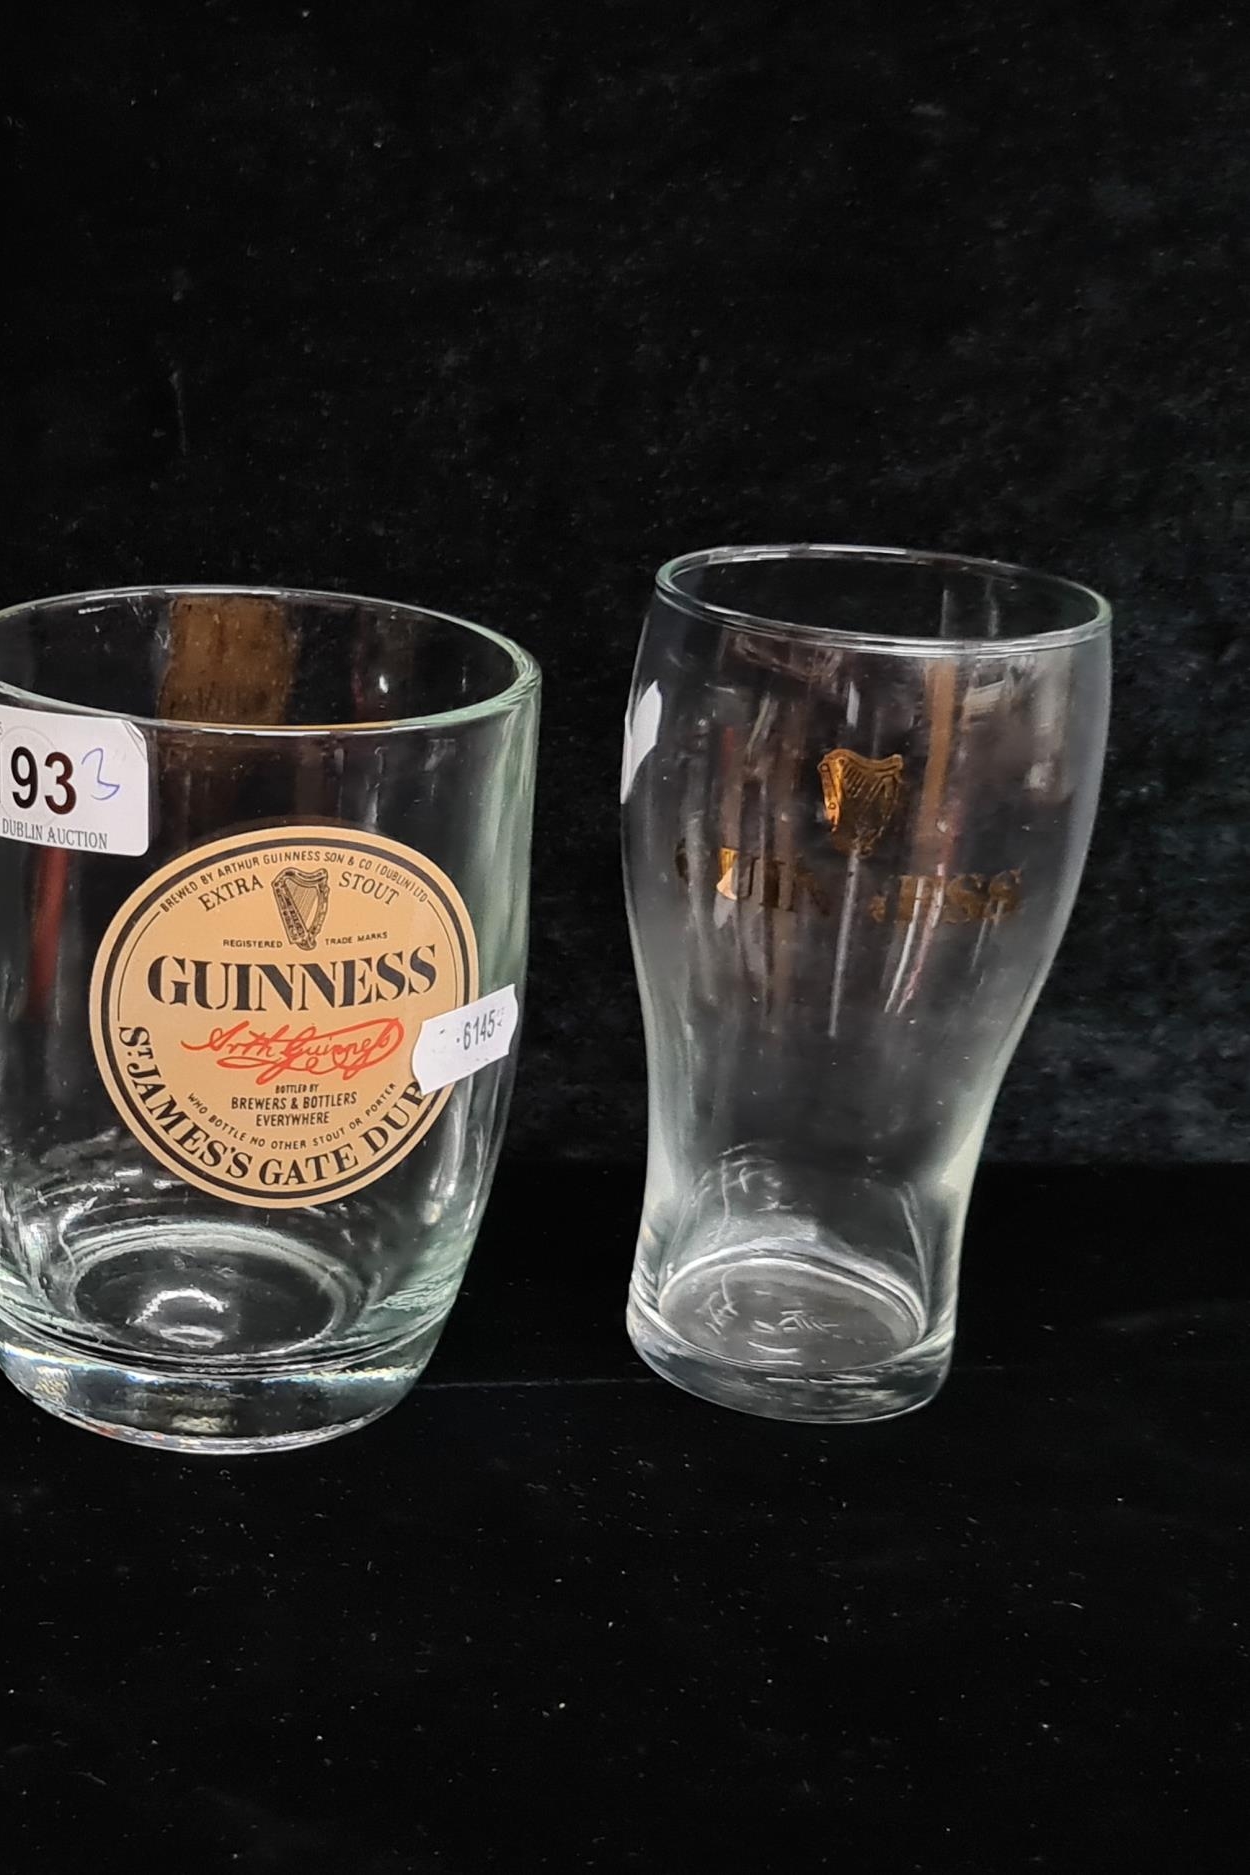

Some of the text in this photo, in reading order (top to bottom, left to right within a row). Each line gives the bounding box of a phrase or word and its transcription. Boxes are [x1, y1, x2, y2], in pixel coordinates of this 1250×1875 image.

[2, 820, 43, 841] DUBLIN
[46, 829, 108, 850] AUCTION
[160, 881, 199, 913] BREWED
[200, 872, 214, 886] BY
[217, 856, 259, 878] ARTHUR
[263, 850, 320, 865] GUINNESS
[324, 851, 344, 863] SON
[346, 855, 356, 866] &
[358, 858, 372, 871] CO
[412, 886, 429, 903] LTD
[198, 871, 400, 911] EXTRA STOUT
[223, 931, 388, 948] REGISTERED TRADE MARKS
[147, 944, 437, 1012] GUINNESS
[231, 1092, 358, 1110] BREWERS & BOTTLERS
[275, 1084, 320, 1094] BOTTLED BY
[187, 1082, 396, 1150] WHO BOTTLE NO OTHER STOUT OR PORTER
[256, 1111, 330, 1127] EVERYWHERE
[259, 1143, 359, 1186] GATE
